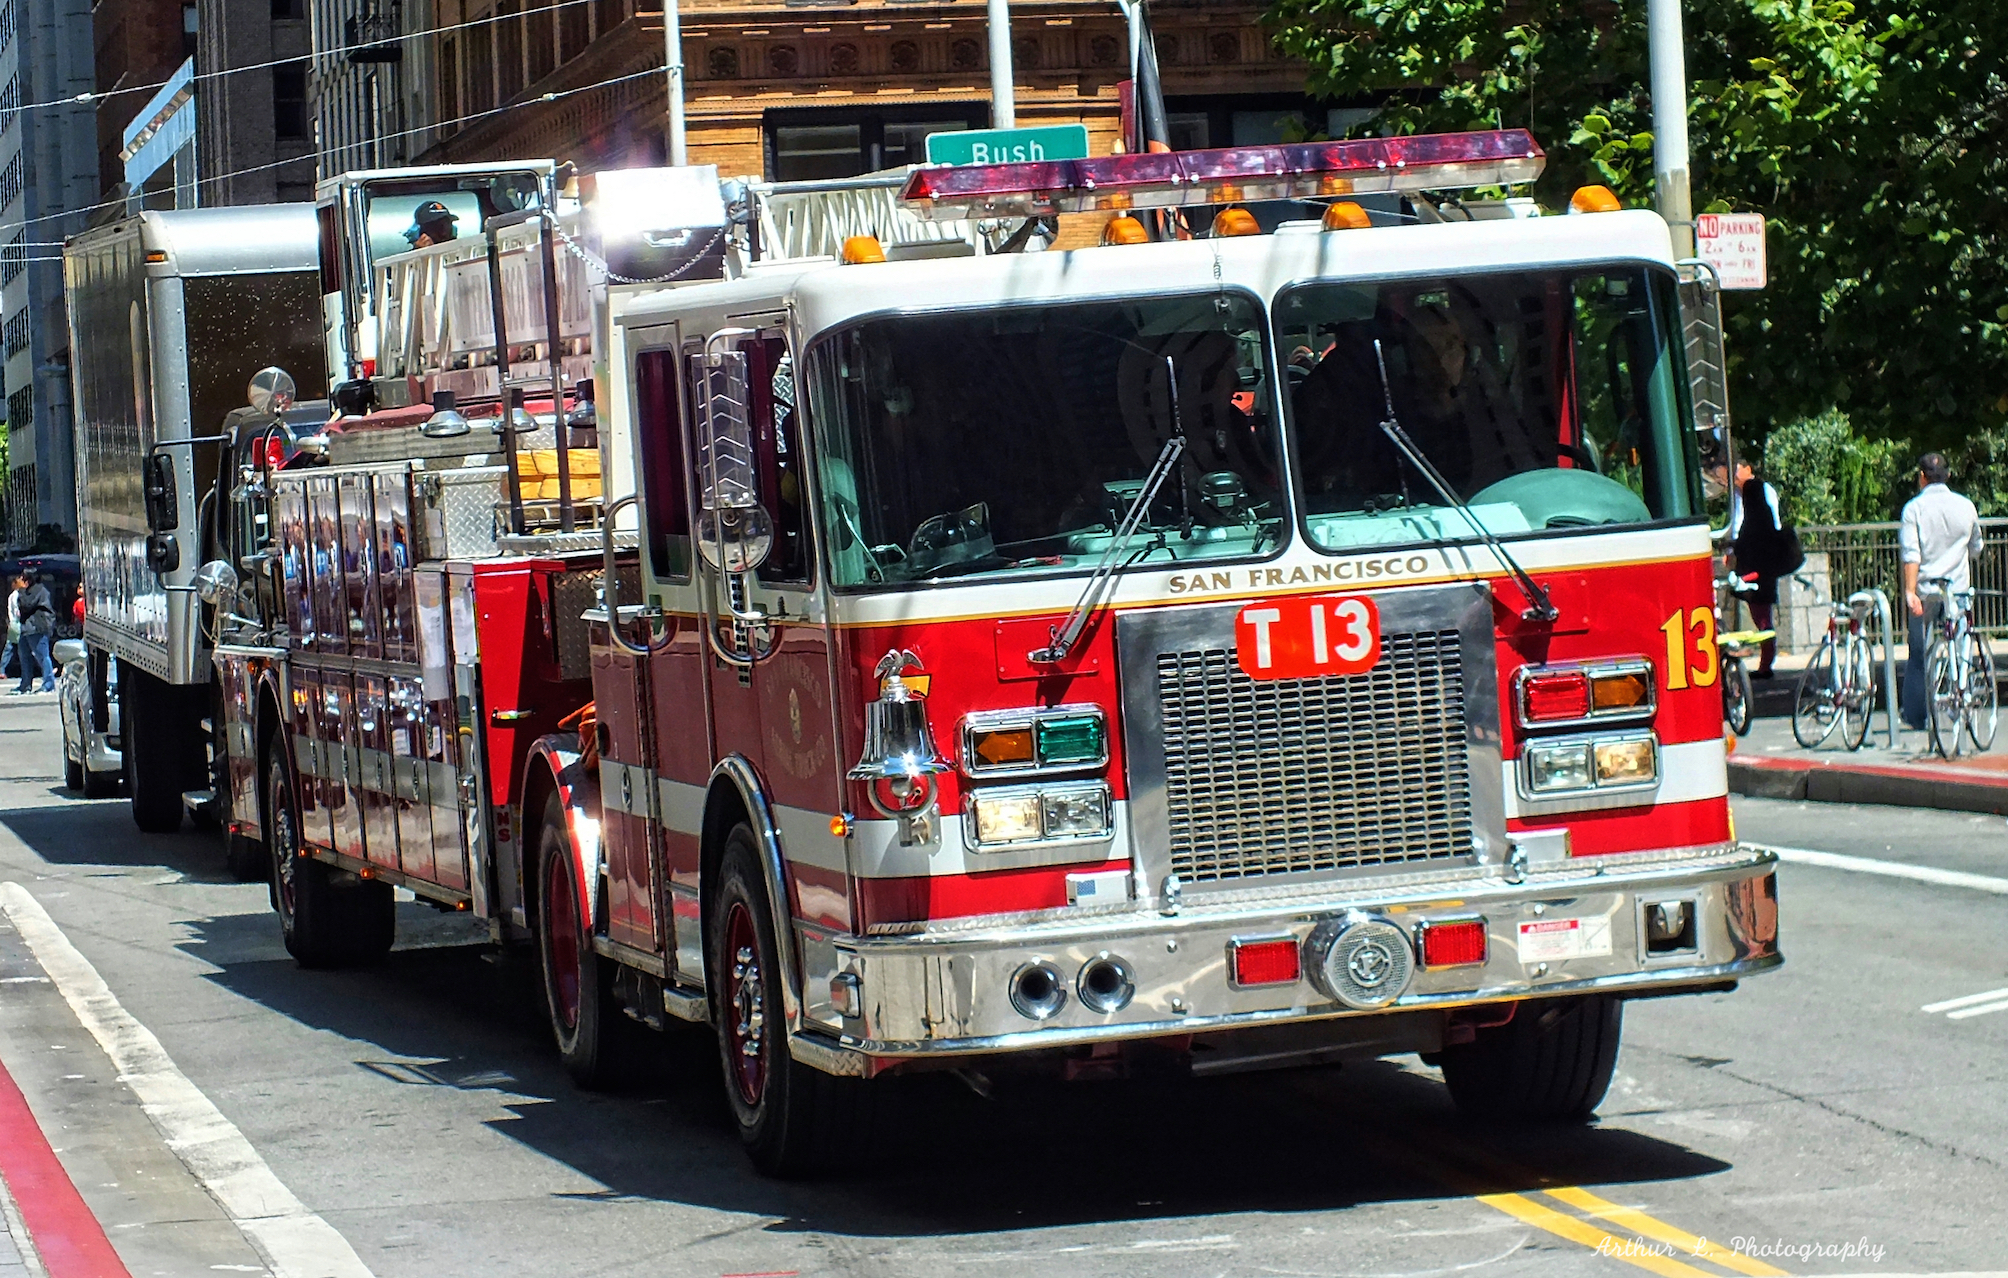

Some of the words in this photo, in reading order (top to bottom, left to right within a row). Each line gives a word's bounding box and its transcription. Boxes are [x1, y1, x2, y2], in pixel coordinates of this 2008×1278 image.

[972, 139, 1045, 166] Bush
[1699, 216, 1718, 237] NO
[1720, 221, 1761, 236] PARKING
[1168, 571, 1232, 595] SAN
[1249, 555, 1429, 589] FRANCISCO
[1243, 607, 1281, 669] T
[1310, 599, 1374, 665] 13
[1658, 605, 1719, 691] 13
